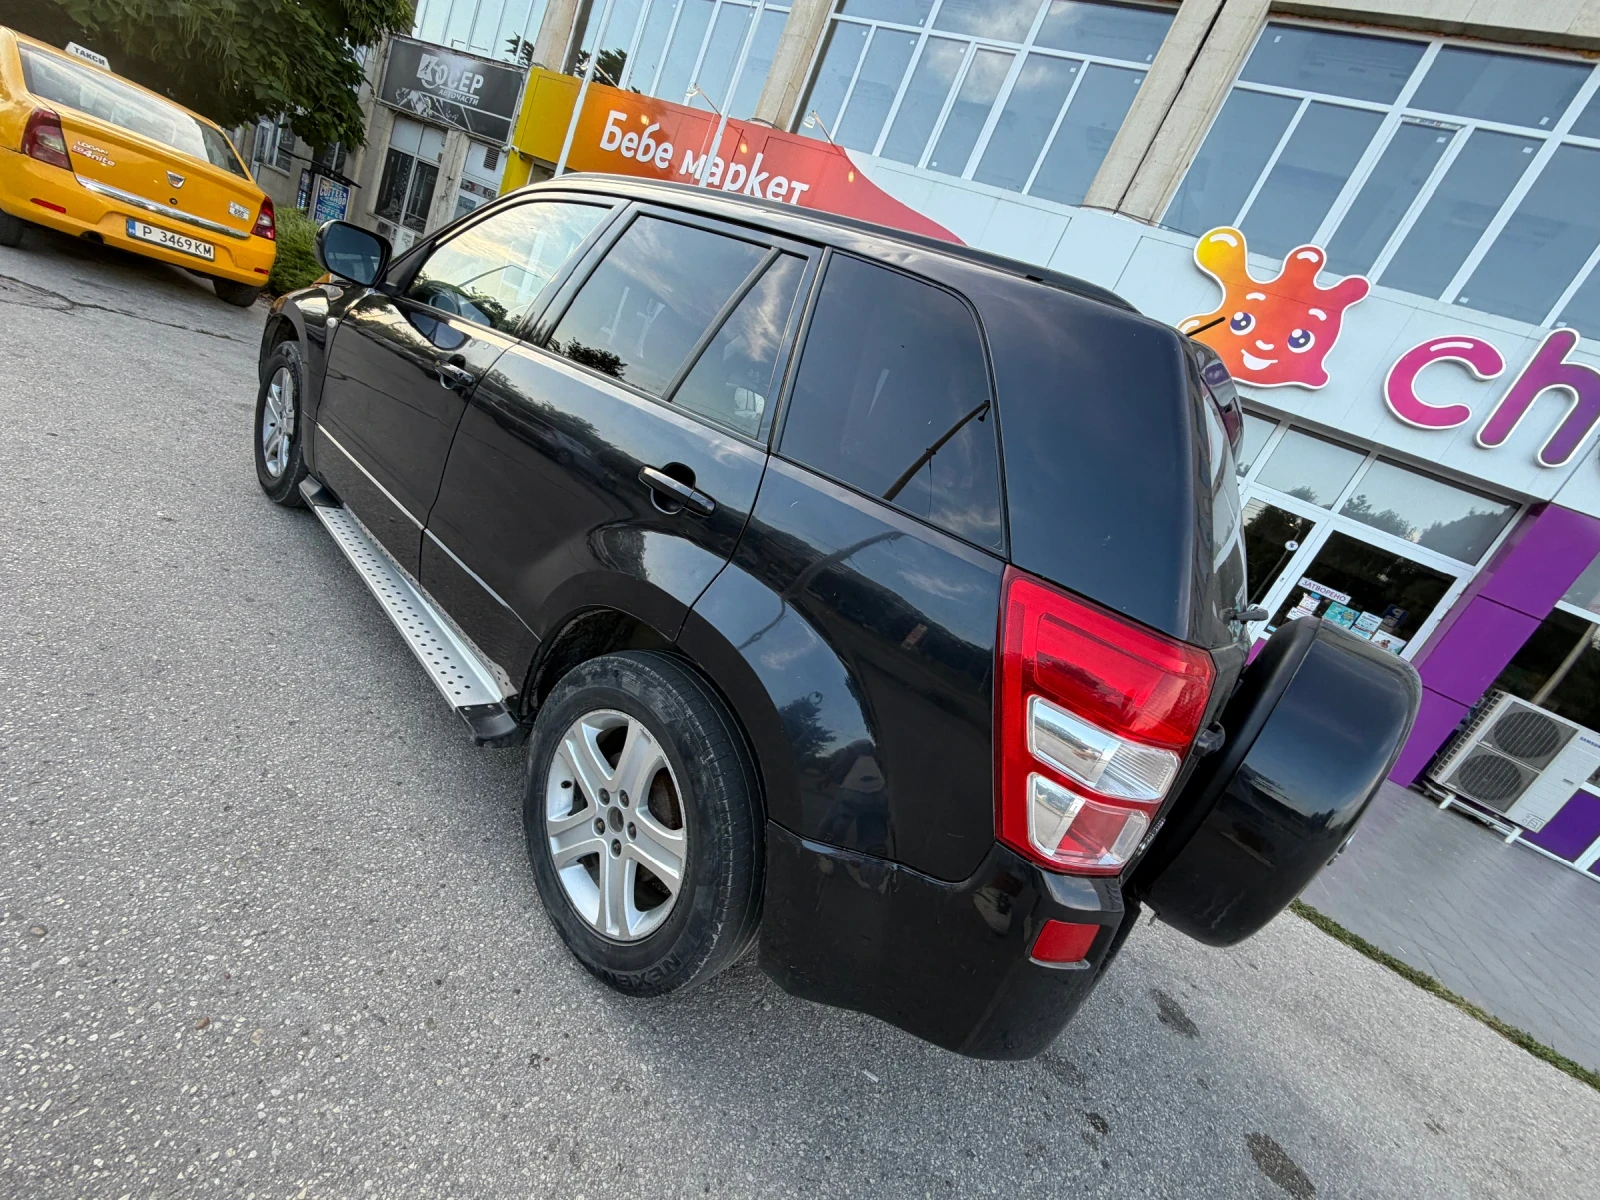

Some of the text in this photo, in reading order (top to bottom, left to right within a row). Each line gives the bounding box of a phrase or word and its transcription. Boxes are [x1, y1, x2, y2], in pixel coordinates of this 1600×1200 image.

[74, 46, 105, 66] ТАКСИ
[438, 88, 480, 106] АВТОЧАСТИ
[600, 109, 674, 169] Бебе
[316, 204, 344, 219] COFFEE
[1302, 580, 1346, 602] ЗАТВОРЕНО
[602, 952, 682, 988] NEXEN
